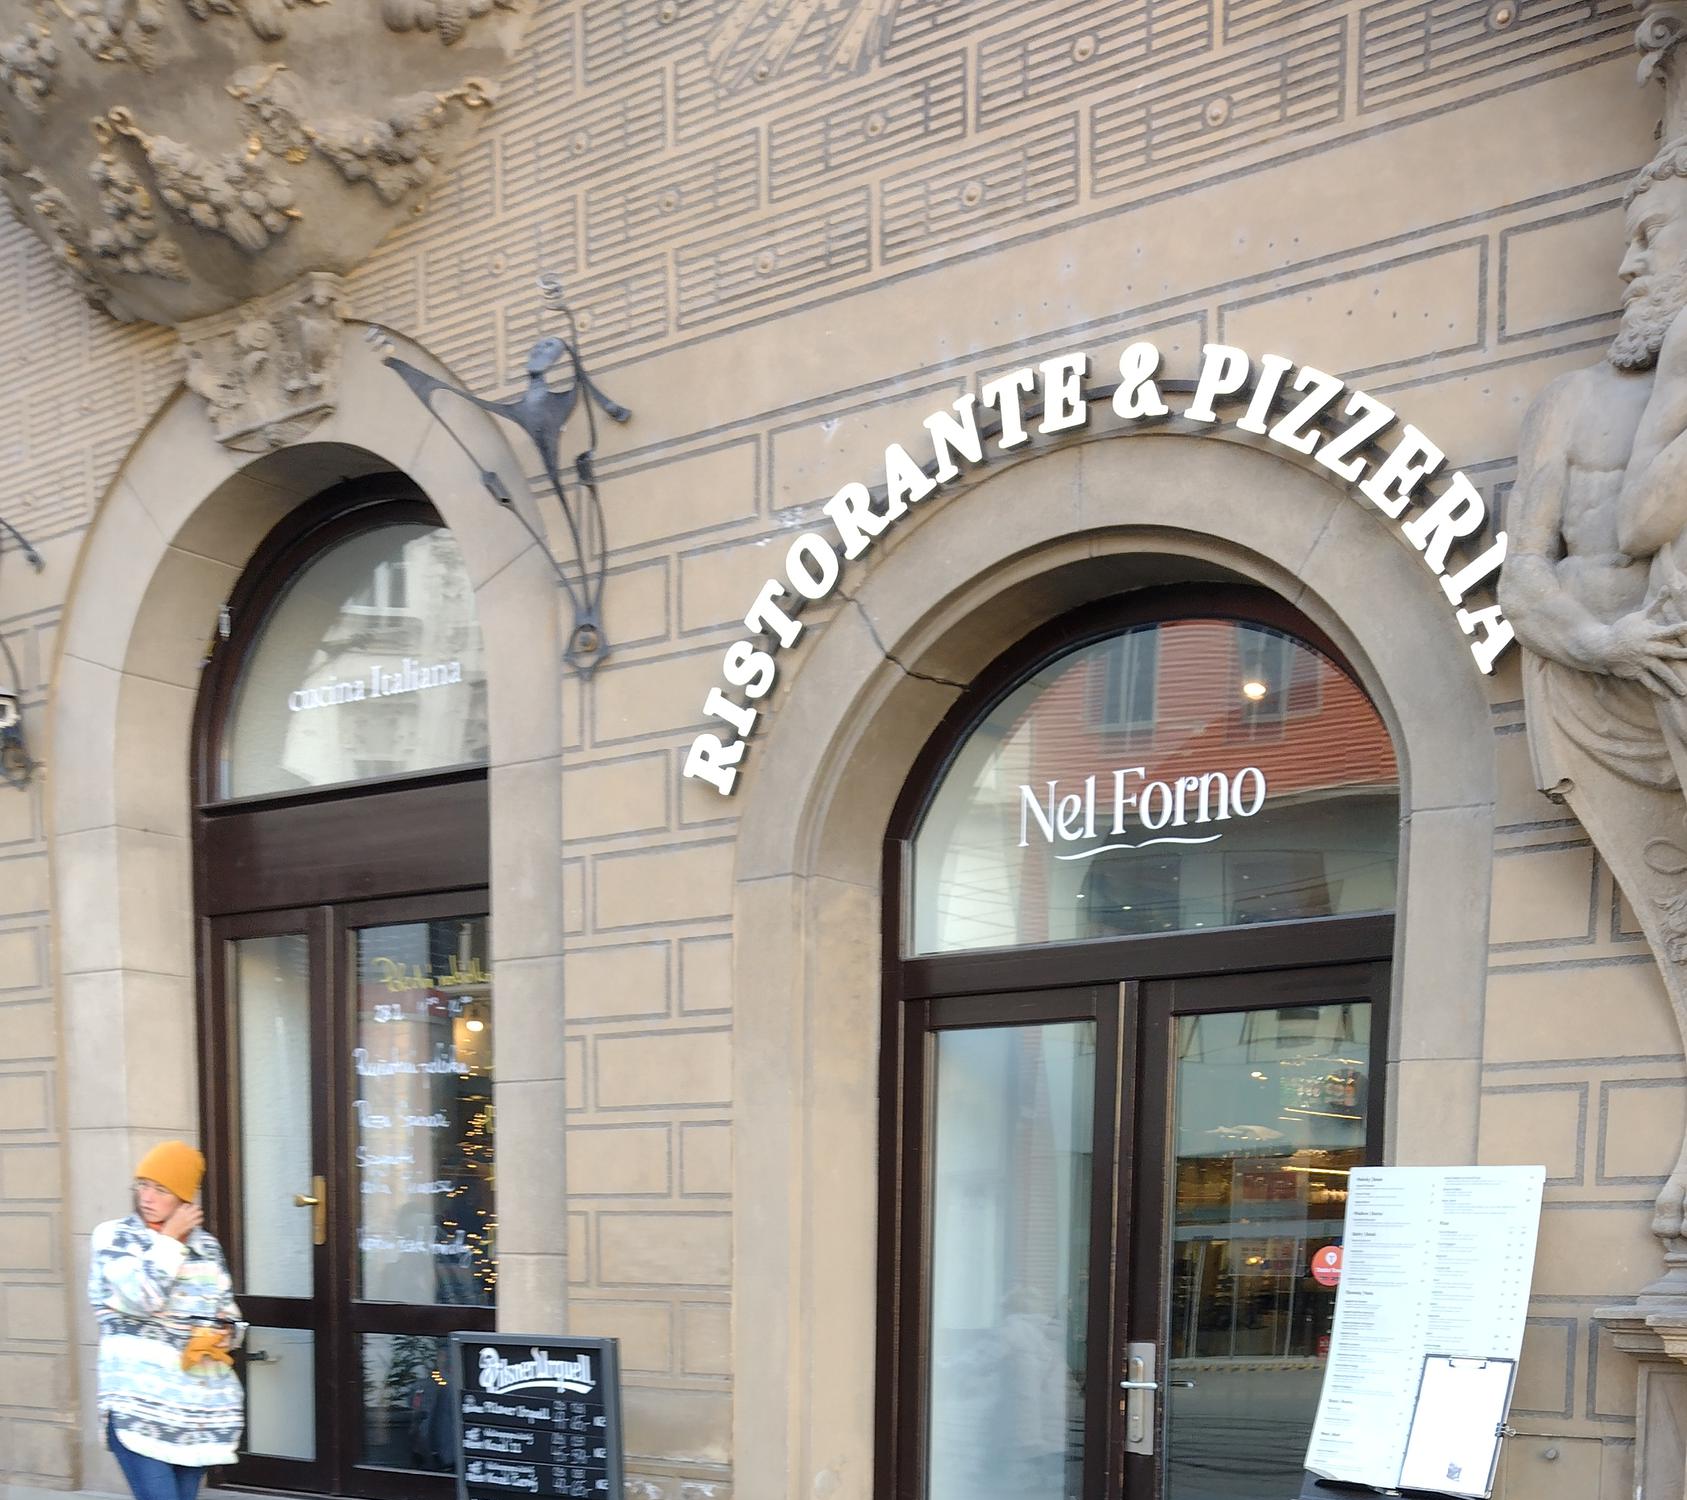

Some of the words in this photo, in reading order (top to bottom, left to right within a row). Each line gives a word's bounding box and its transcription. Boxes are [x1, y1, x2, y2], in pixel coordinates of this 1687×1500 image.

[684, 352, 1088, 796] RISTORANTE
[1112, 342, 1169, 419] &
[1184, 344, 1516, 675] PIZZERIA
[1017, 775, 1098, 847] Nel
[1110, 767, 1267, 836] Forno
